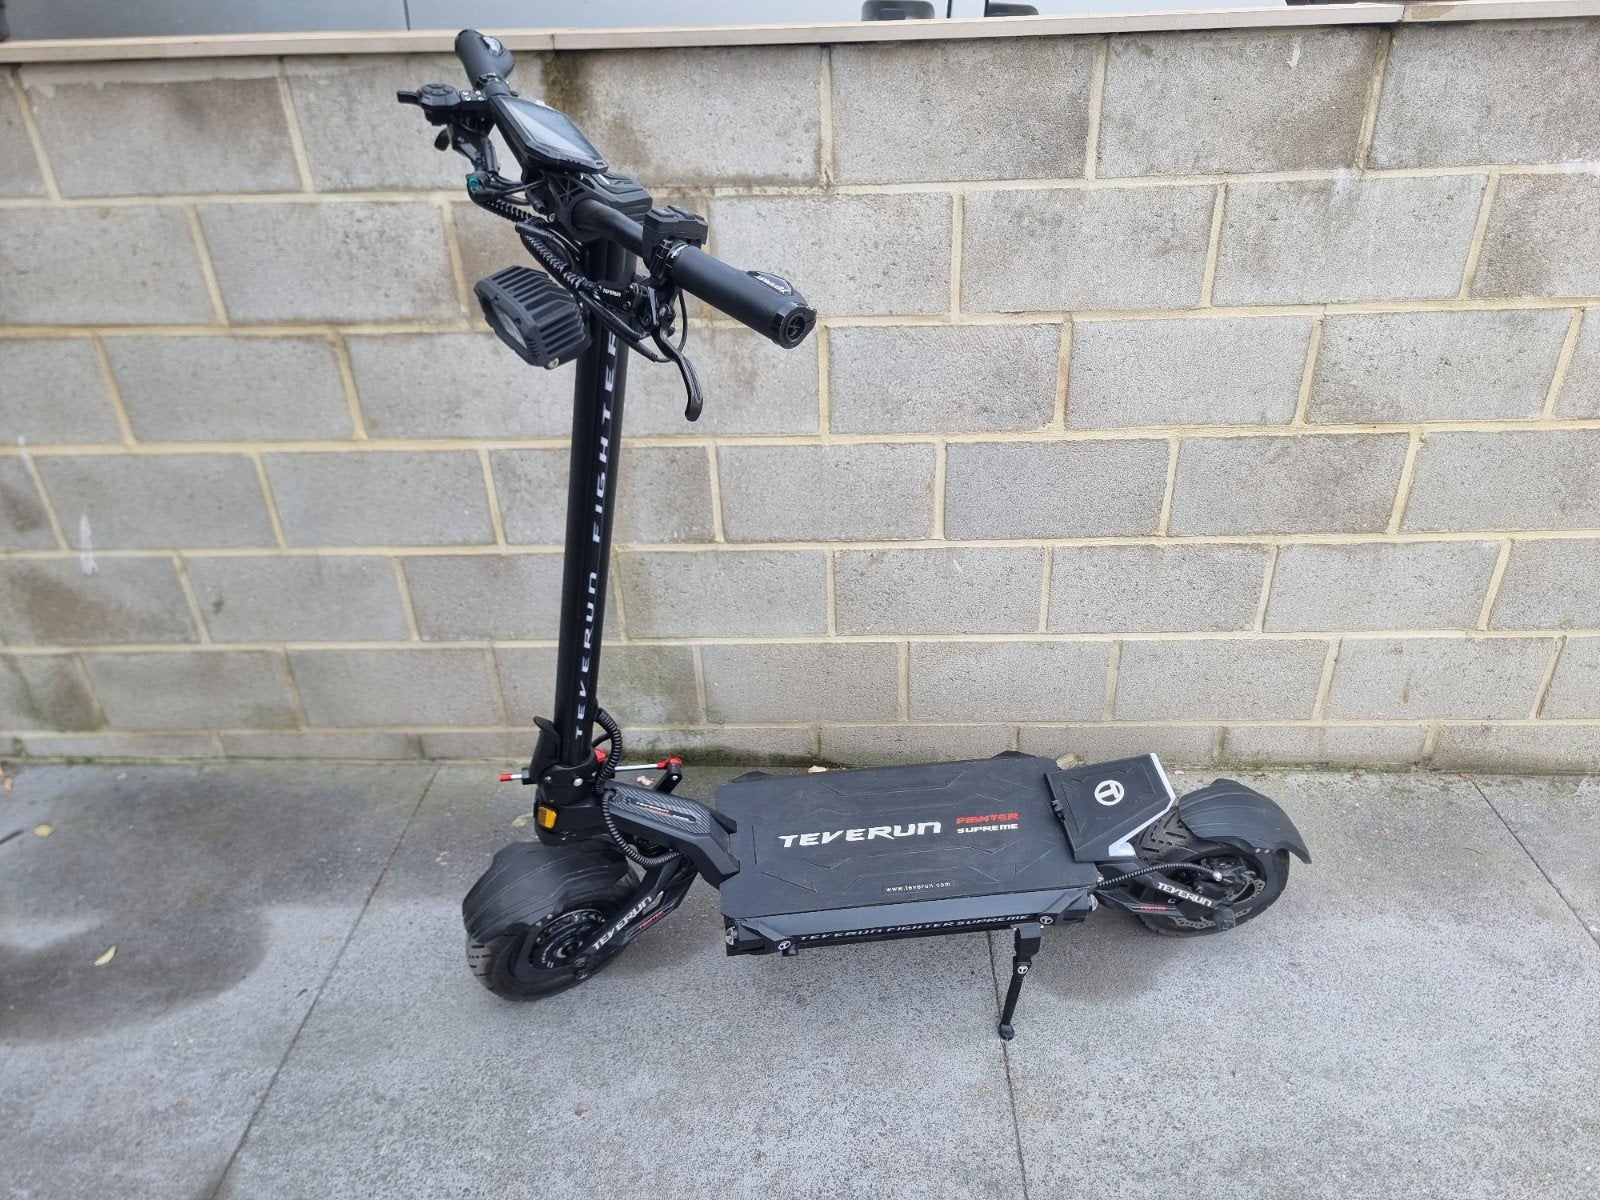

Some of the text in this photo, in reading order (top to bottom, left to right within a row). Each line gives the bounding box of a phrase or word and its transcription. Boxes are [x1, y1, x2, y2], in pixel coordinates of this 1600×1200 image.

[575, 571, 598, 740] TEVERUN
[955, 812, 1020, 824] FIGHTER
[957, 823, 1019, 834] SUPREME
[777, 820, 942, 848] TEVERUN
[884, 880, 952, 893] www.teverun.com
[1157, 881, 1212, 907] TEVERUN
[592, 895, 653, 950] TEVERUN
